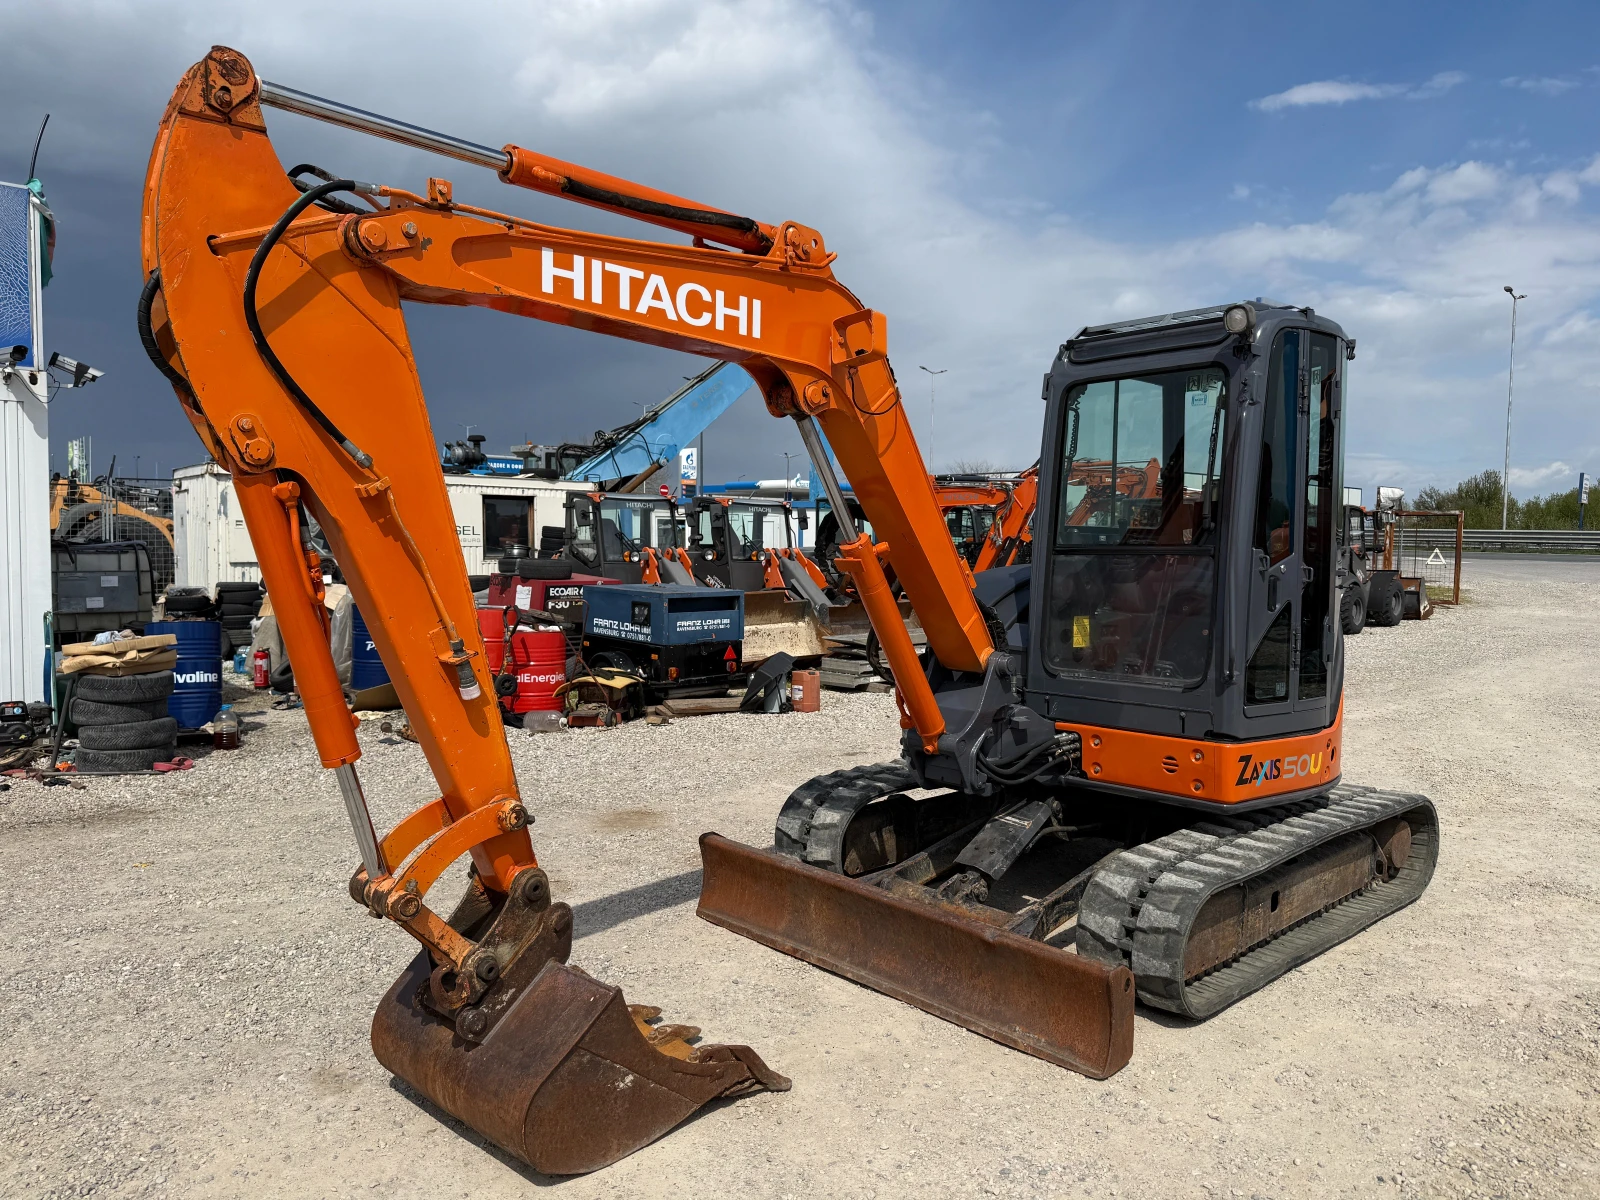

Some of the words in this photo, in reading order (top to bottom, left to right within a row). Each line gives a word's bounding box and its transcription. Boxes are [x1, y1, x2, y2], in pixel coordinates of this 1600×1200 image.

[541, 246, 762, 340] HITACHI
[549, 587, 579, 597] ECOAIR
[593, 618, 619, 629] FRANZ
[619, 621, 641, 633] LOHR
[702, 618, 721, 626] LOHR
[593, 626, 620, 637] RAVENSBURG
[1235, 755, 1281, 787] ZAXIS
